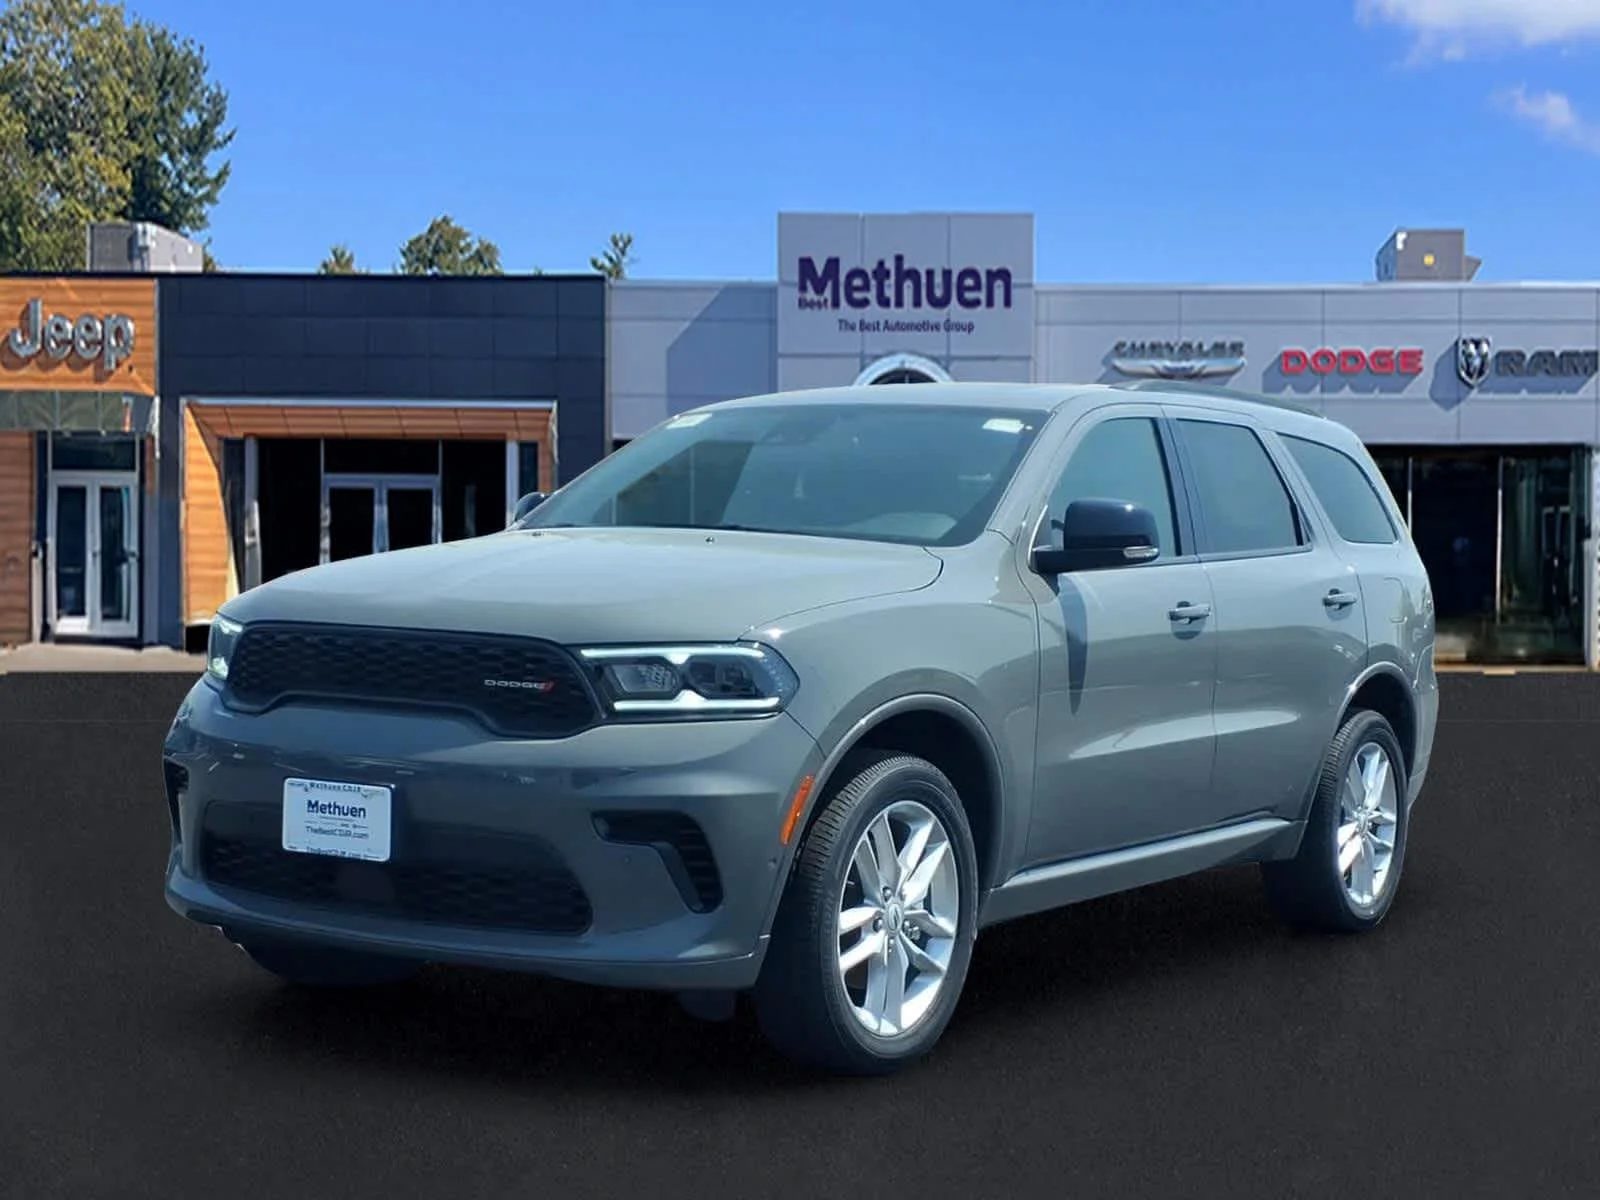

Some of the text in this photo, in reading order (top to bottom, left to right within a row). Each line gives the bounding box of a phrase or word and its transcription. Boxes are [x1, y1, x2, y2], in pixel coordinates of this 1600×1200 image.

[798, 254, 1012, 309] Methuen
[798, 297, 829, 310] Best
[9, 298, 136, 371] Jeep
[838, 319, 975, 335] The Best Automotive Group
[1282, 349, 1424, 374] DODGE
[1495, 351, 1599, 376] RAM
[484, 680, 545, 689] DODGE
[307, 800, 366, 819] Methuen
